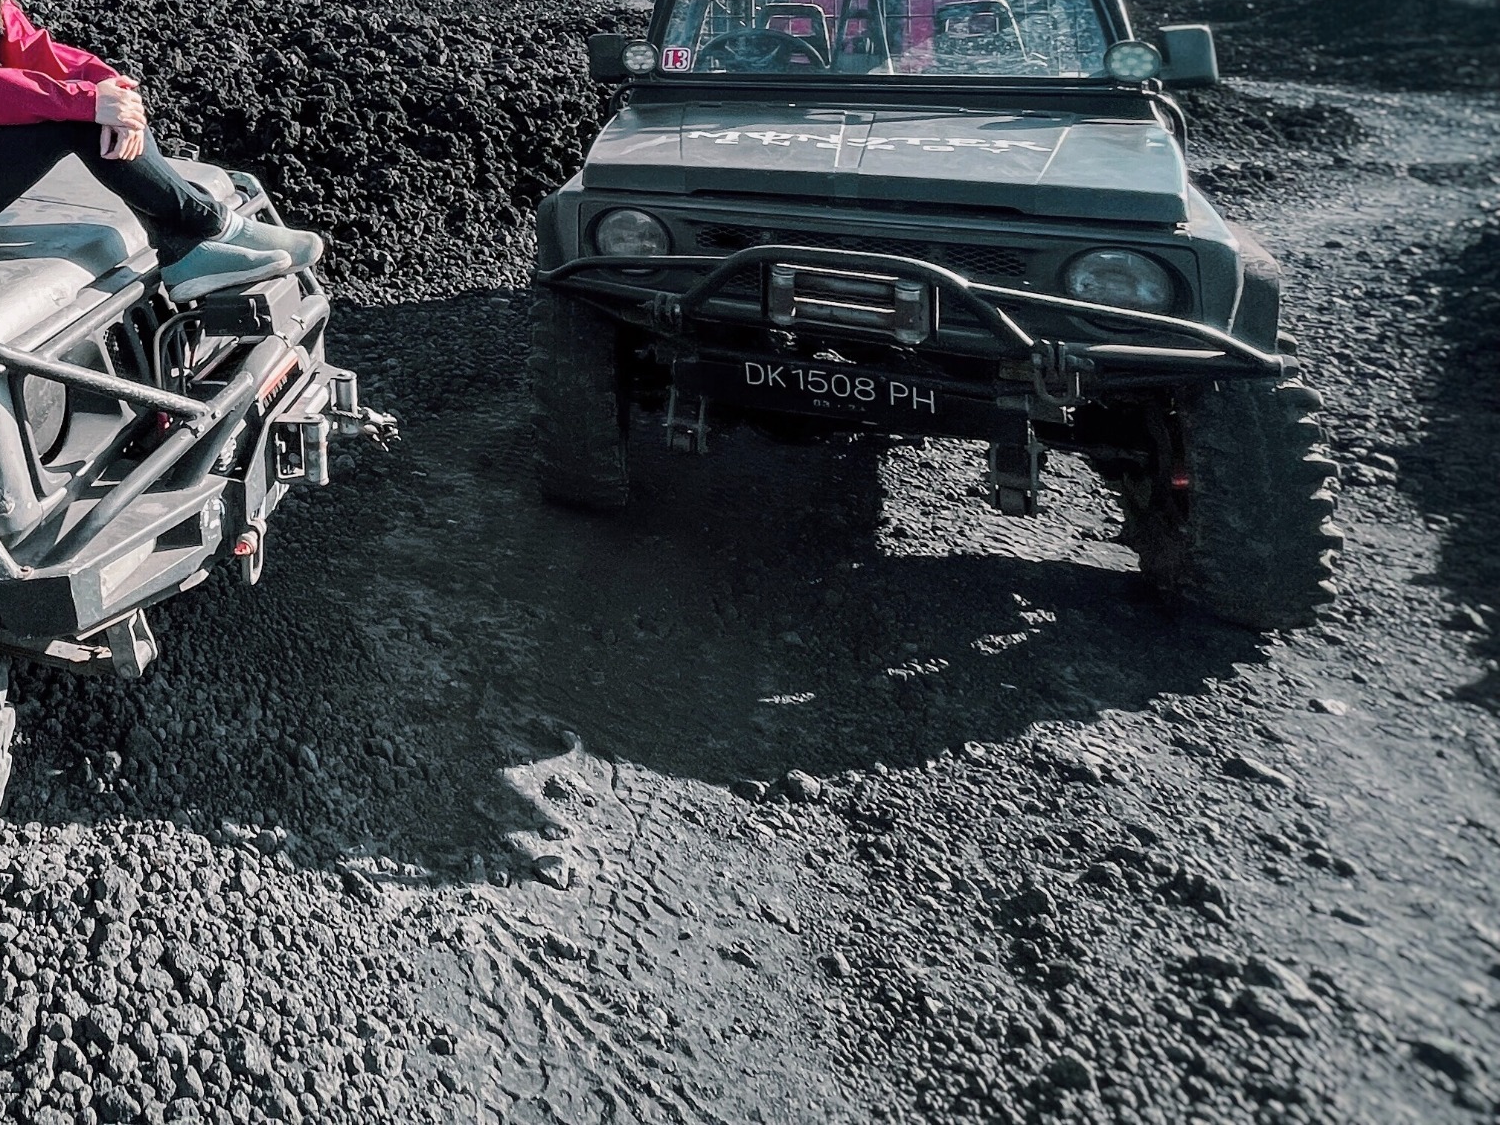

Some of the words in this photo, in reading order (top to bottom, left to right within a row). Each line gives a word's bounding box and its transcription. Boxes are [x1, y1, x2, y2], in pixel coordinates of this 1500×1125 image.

[665, 50, 688, 69] 13
[745, 362, 786, 387] DK
[792, 369, 876, 401] 1508
[889, 381, 935, 414] PH
